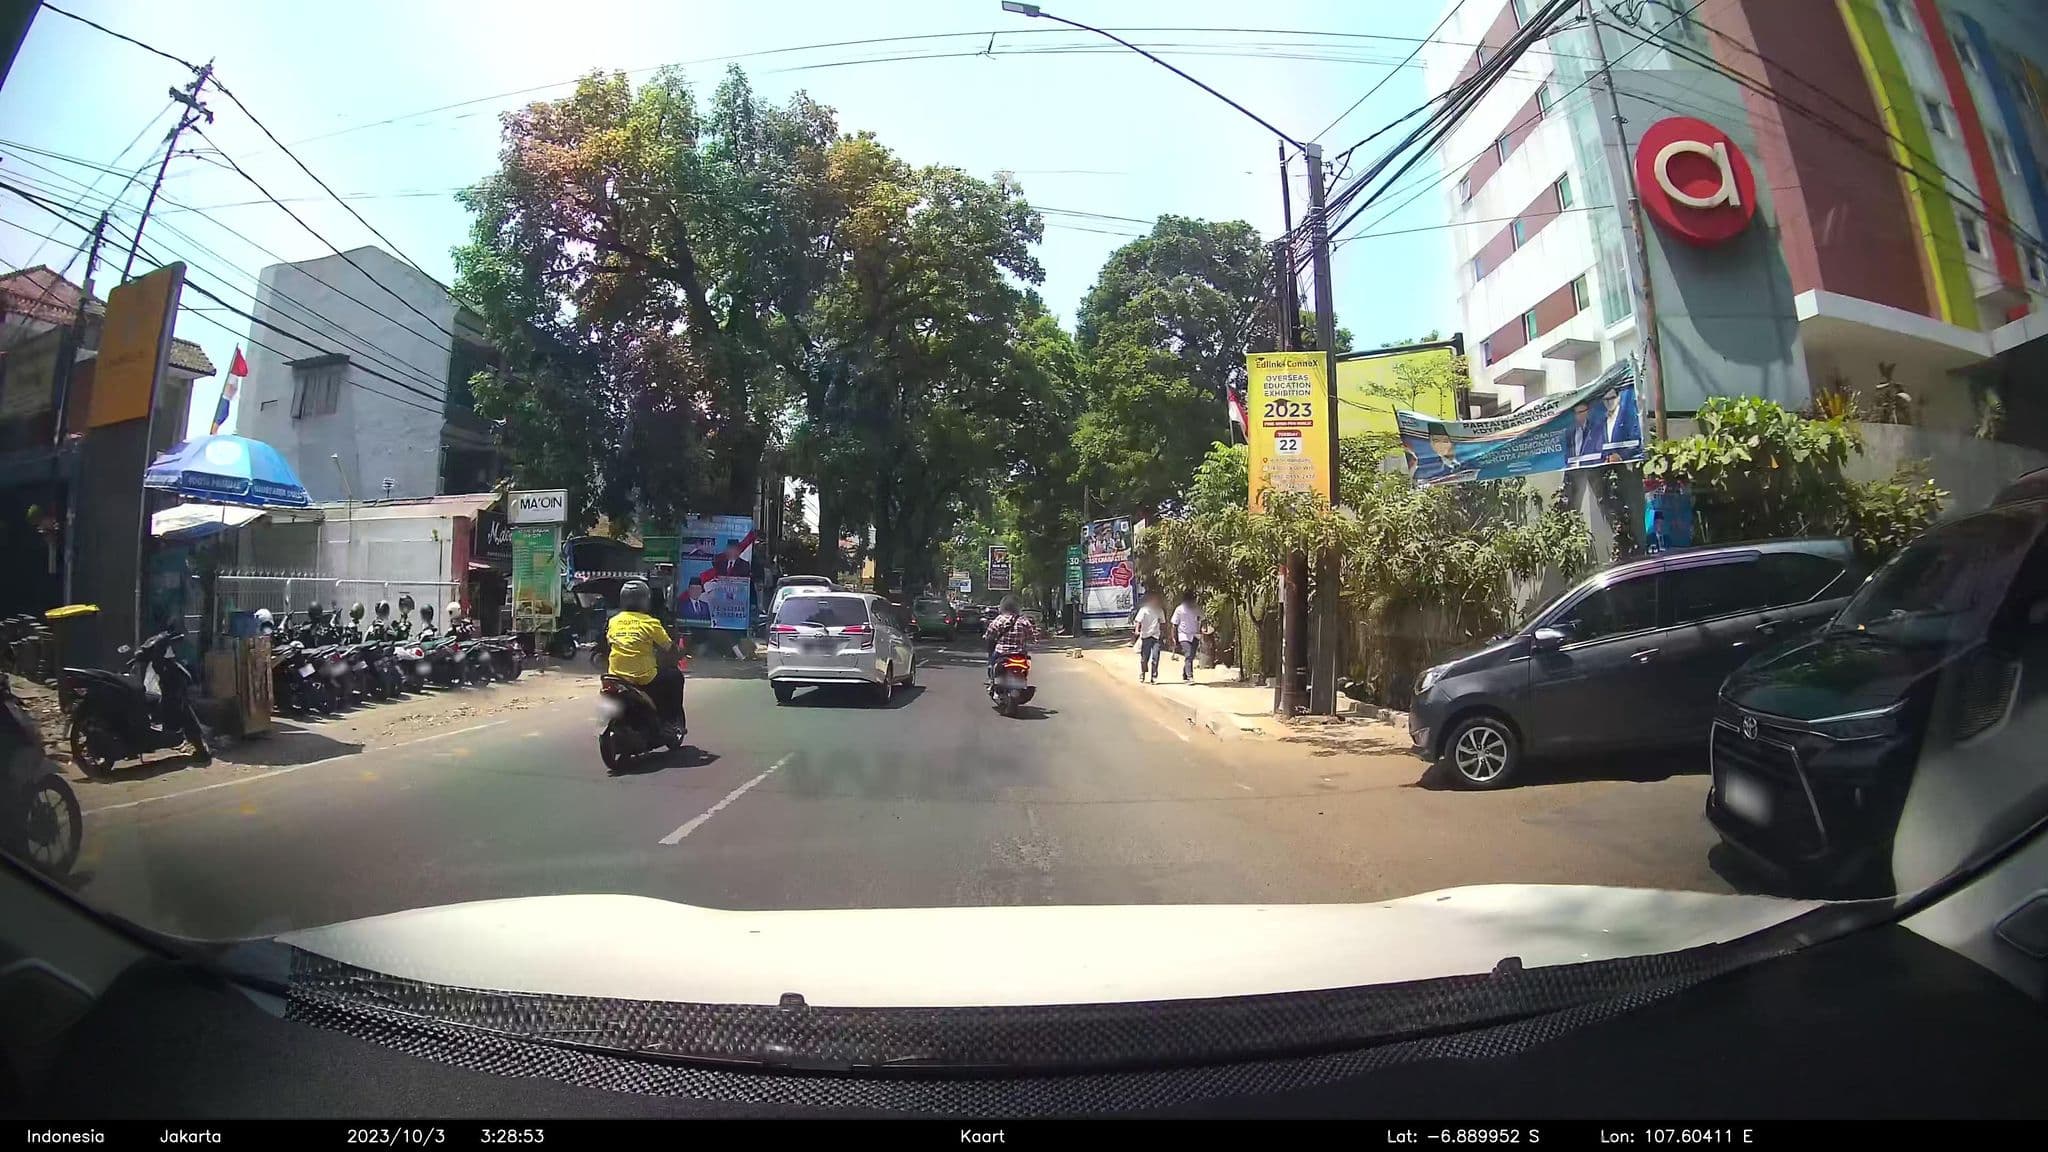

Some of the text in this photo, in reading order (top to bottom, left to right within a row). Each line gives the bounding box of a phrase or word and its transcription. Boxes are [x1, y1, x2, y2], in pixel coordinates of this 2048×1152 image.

[1654, 140, 1741, 209] a
[1266, 374, 1309, 382] OVERSEAS
[1263, 382, 1311, 390] EDUCATION
[1264, 403, 1312, 418] 2023
[1463, 420, 1500, 430] PARTAI
[1279, 439, 1297, 451] 22
